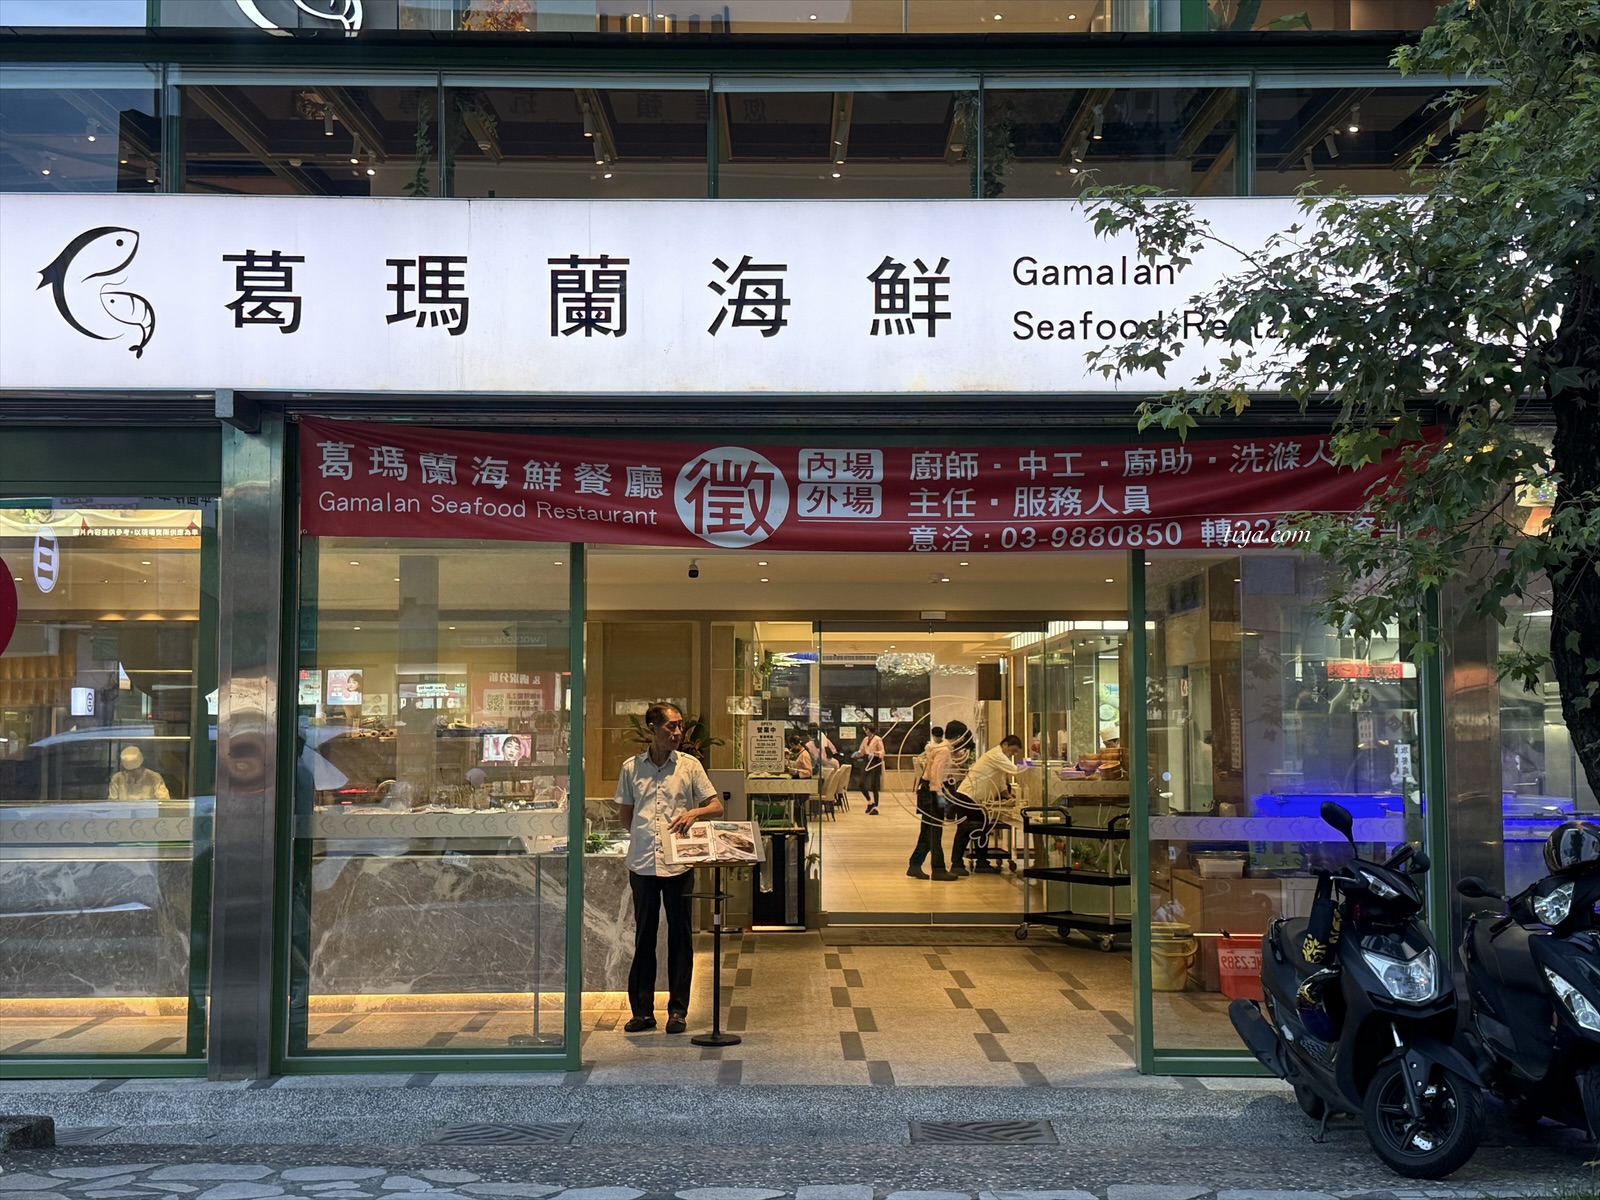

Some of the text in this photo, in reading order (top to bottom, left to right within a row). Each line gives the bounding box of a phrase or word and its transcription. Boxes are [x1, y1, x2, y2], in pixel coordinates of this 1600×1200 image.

[222, 249, 952, 338] 葛瑪蘭海鮮
[1012, 255, 1175, 286] Gamalan
[316, 440, 664, 500] 葛瑪蘭海鮮餐廳
[318, 491, 658, 525] Gamalan Seafood Restaurant
[683, 456, 777, 538] 徵
[806, 485, 875, 515] 外場
